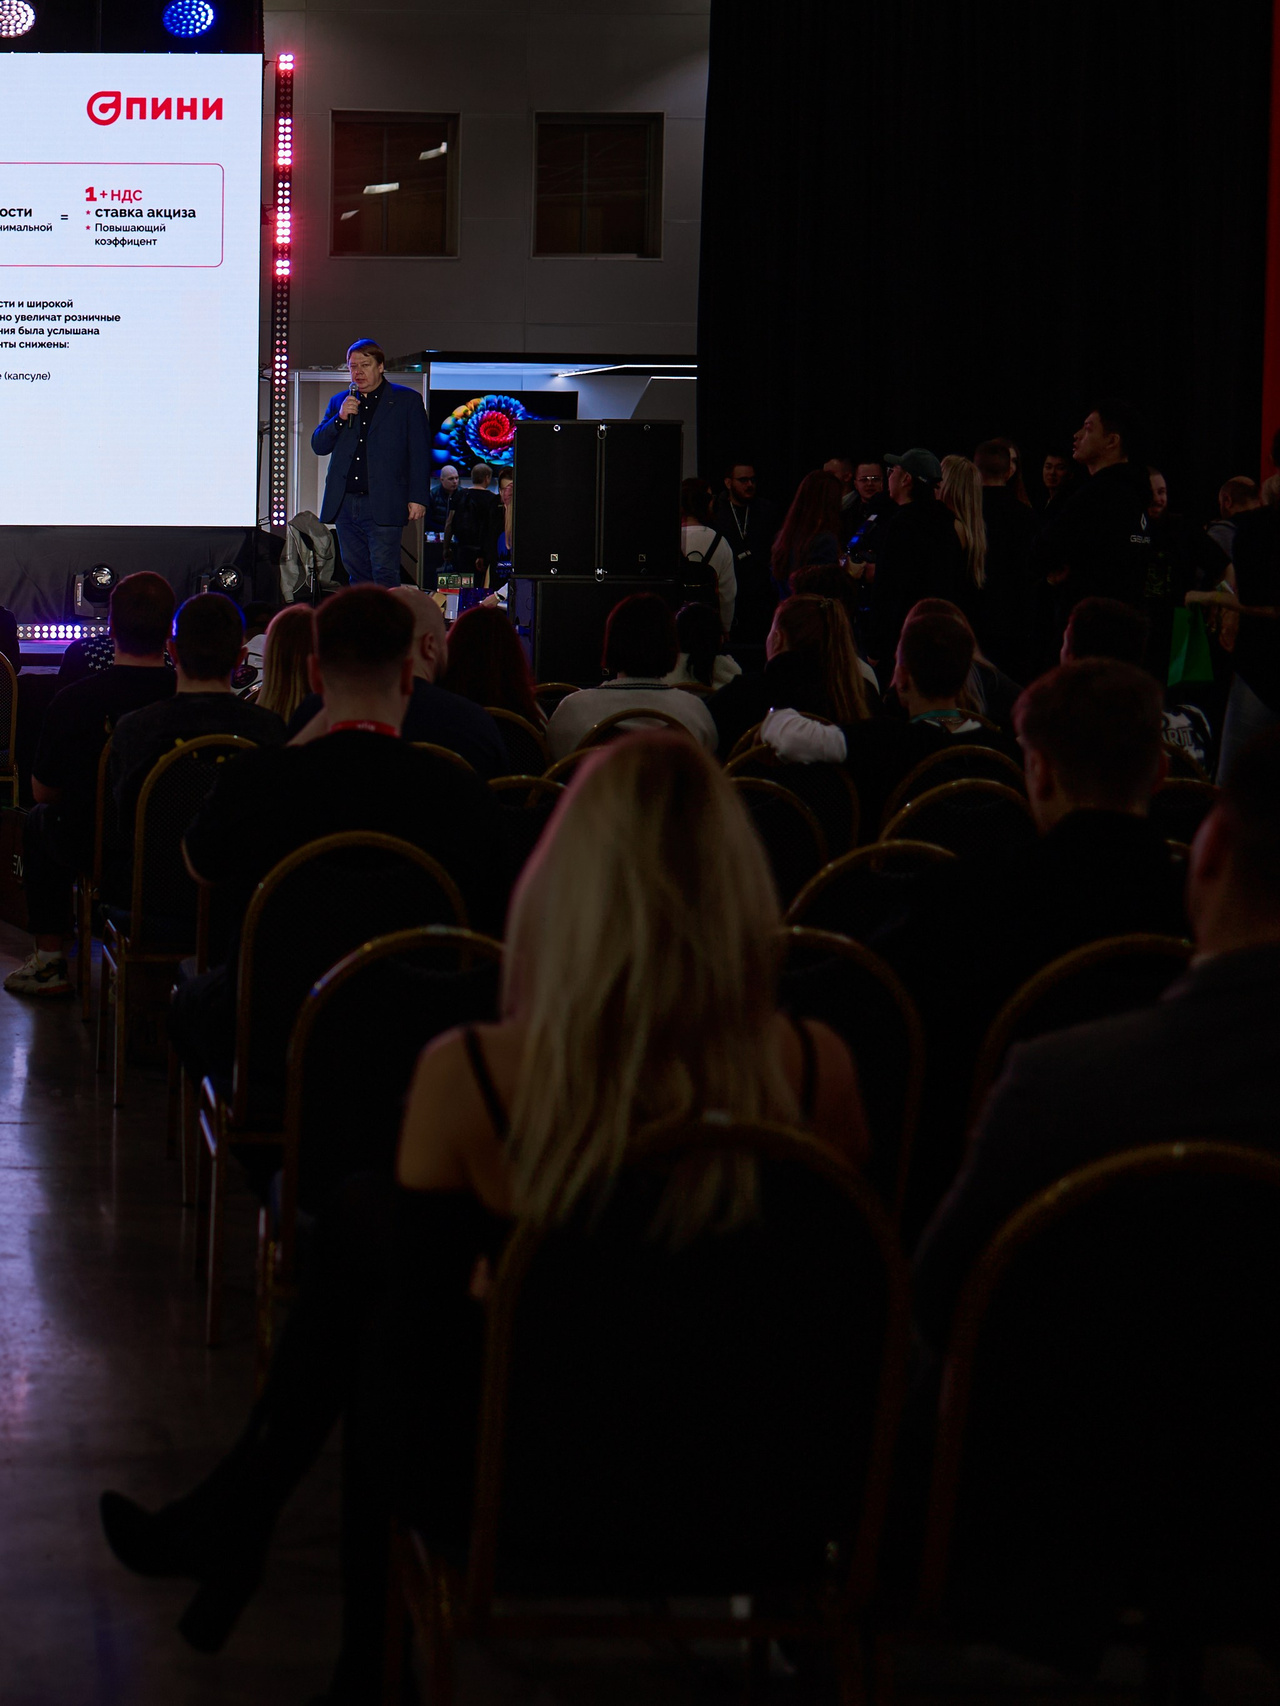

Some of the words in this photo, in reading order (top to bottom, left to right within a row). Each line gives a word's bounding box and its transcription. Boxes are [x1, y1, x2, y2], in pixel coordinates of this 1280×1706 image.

[84, 186, 98, 202] 1
[110, 189, 143, 204] НДС
[94, 208, 144, 218] ставка
[146, 208, 197, 221] акциза
[94, 222, 166, 234] Повышающий
[94, 236, 158, 248] коэффицент
[26, 298, 74, 311] широкой
[14, 314, 63, 324] увеличат
[64, 314, 122, 324] розничные
[17, 325, 45, 336] была
[46, 327, 100, 337] услышана
[18, 341, 70, 349] снижены:
[3, 371, 51, 383] (капсуле)
